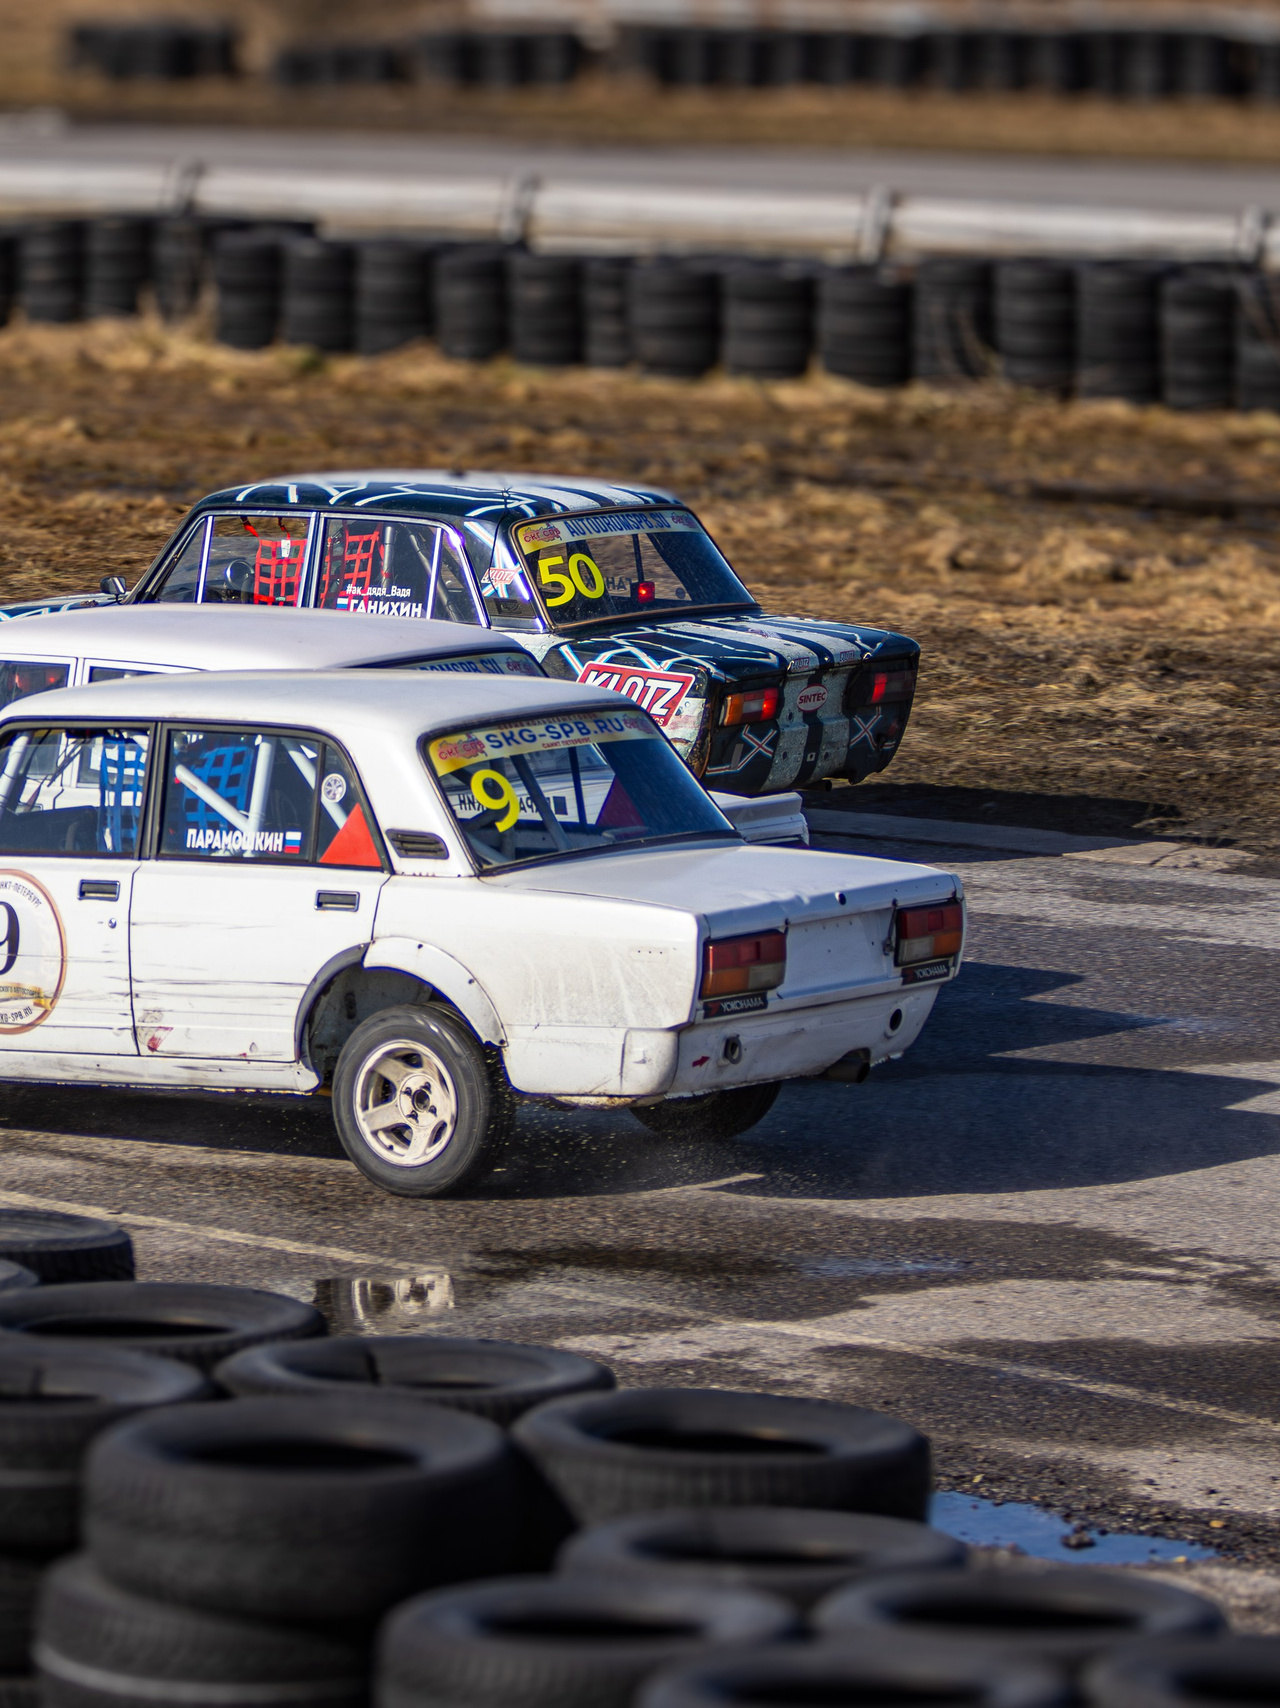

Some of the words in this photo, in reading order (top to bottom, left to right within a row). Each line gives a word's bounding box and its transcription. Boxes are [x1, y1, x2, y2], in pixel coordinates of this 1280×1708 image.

[564, 512, 670, 537] AUTODROMSPB.SU
[538, 553, 605, 607] 50
[349, 599, 422, 618] ГАНИХИН
[798, 692, 826, 704] SINTEC
[485, 717, 624, 749] SKG-SPB.RU
[470, 769, 520, 833] 9
[186, 828, 284, 852] ПАРАМОШКИН
[720, 997, 764, 1013] YOKOHAMA
